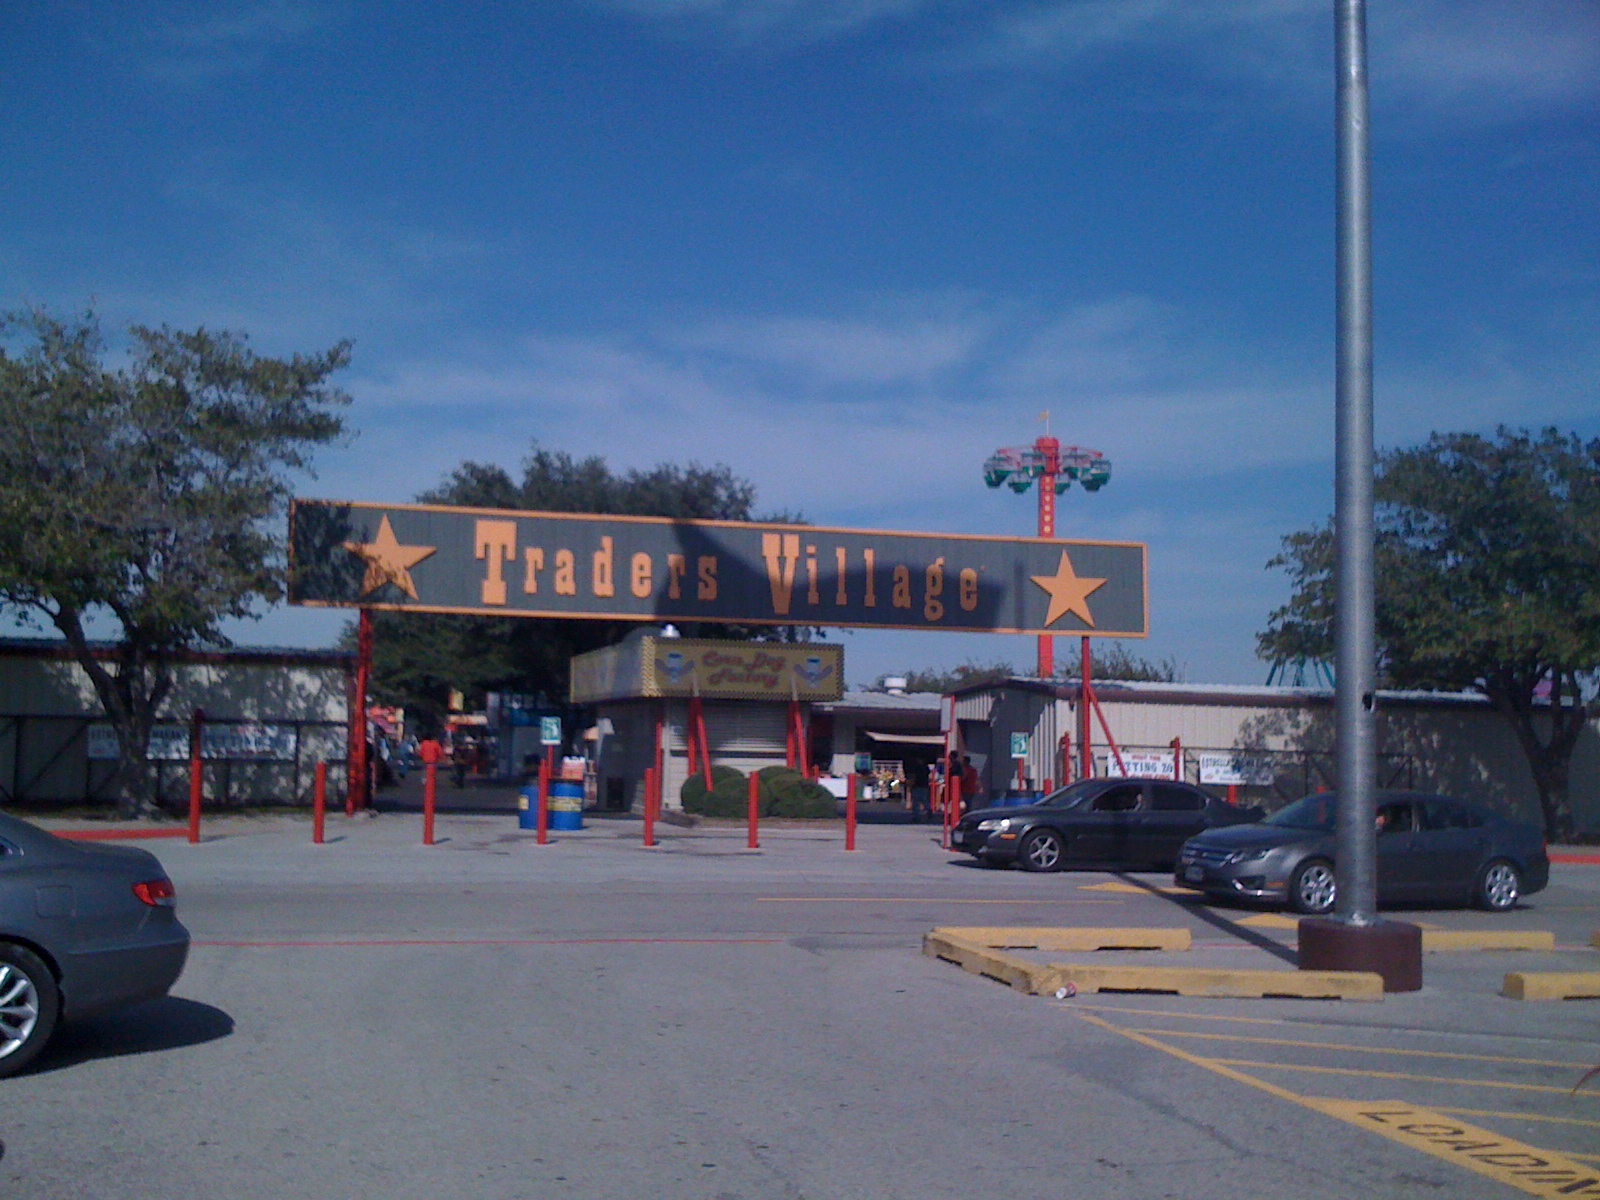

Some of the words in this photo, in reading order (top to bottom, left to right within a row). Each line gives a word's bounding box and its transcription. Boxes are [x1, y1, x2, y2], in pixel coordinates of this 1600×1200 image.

[475, 519, 718, 606] Traders
[761, 533, 978, 622] Village
[1112, 761, 1158, 773] PTTING
[1357, 1110, 1600, 1200] LOADIN
